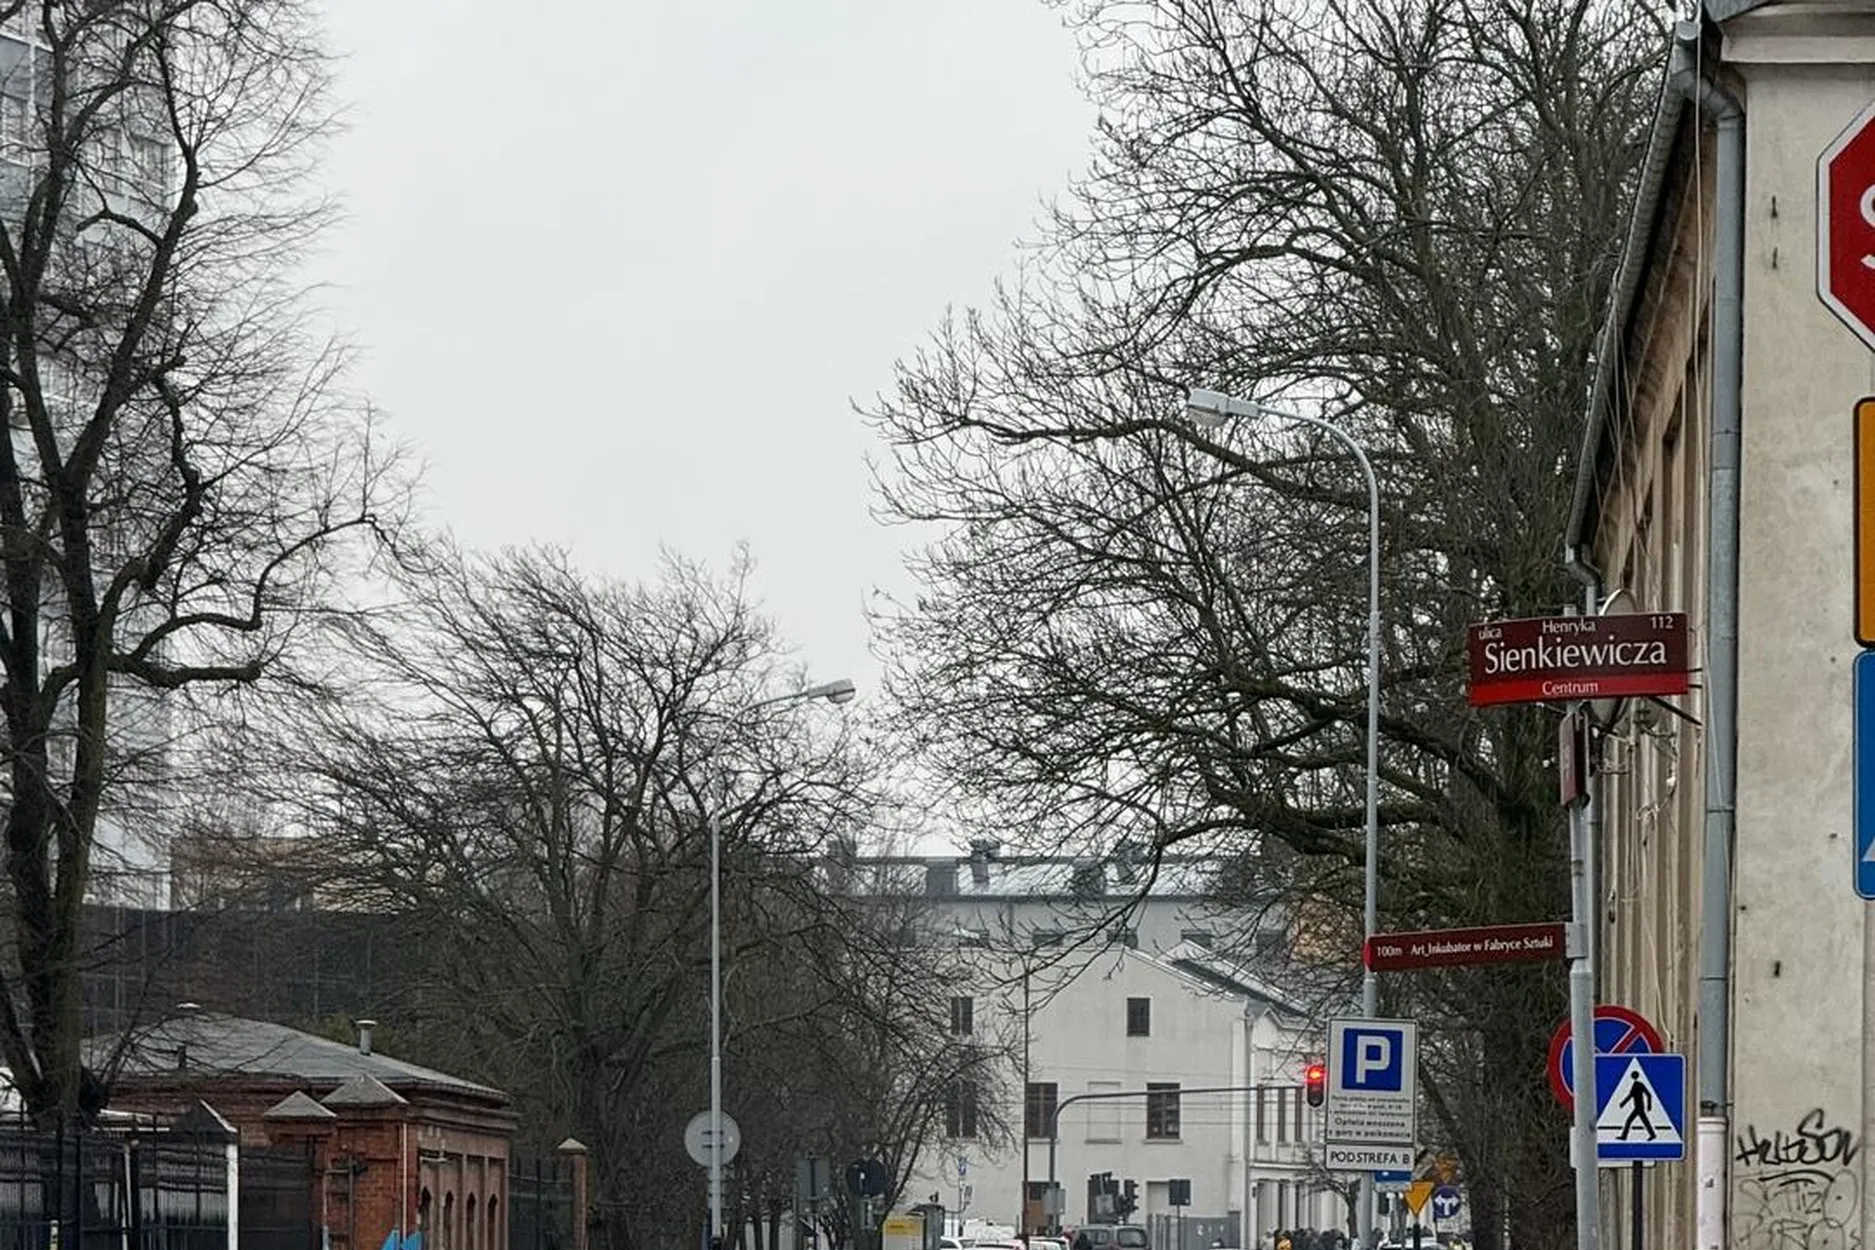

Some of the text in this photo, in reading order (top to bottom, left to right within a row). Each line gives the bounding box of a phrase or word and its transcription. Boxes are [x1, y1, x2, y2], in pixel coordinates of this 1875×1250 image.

[1478, 616, 1674, 640] ulica Henryka 112
[1484, 634, 1667, 675] Sienkiewicza
[1542, 681, 1599, 696] Centrum
[1377, 945, 1403, 958] 100m
[1485, 939, 1522, 954] Fabryce
[1355, 1034, 1391, 1084] P
[1330, 1150, 1410, 1164] PODSTREFA B
